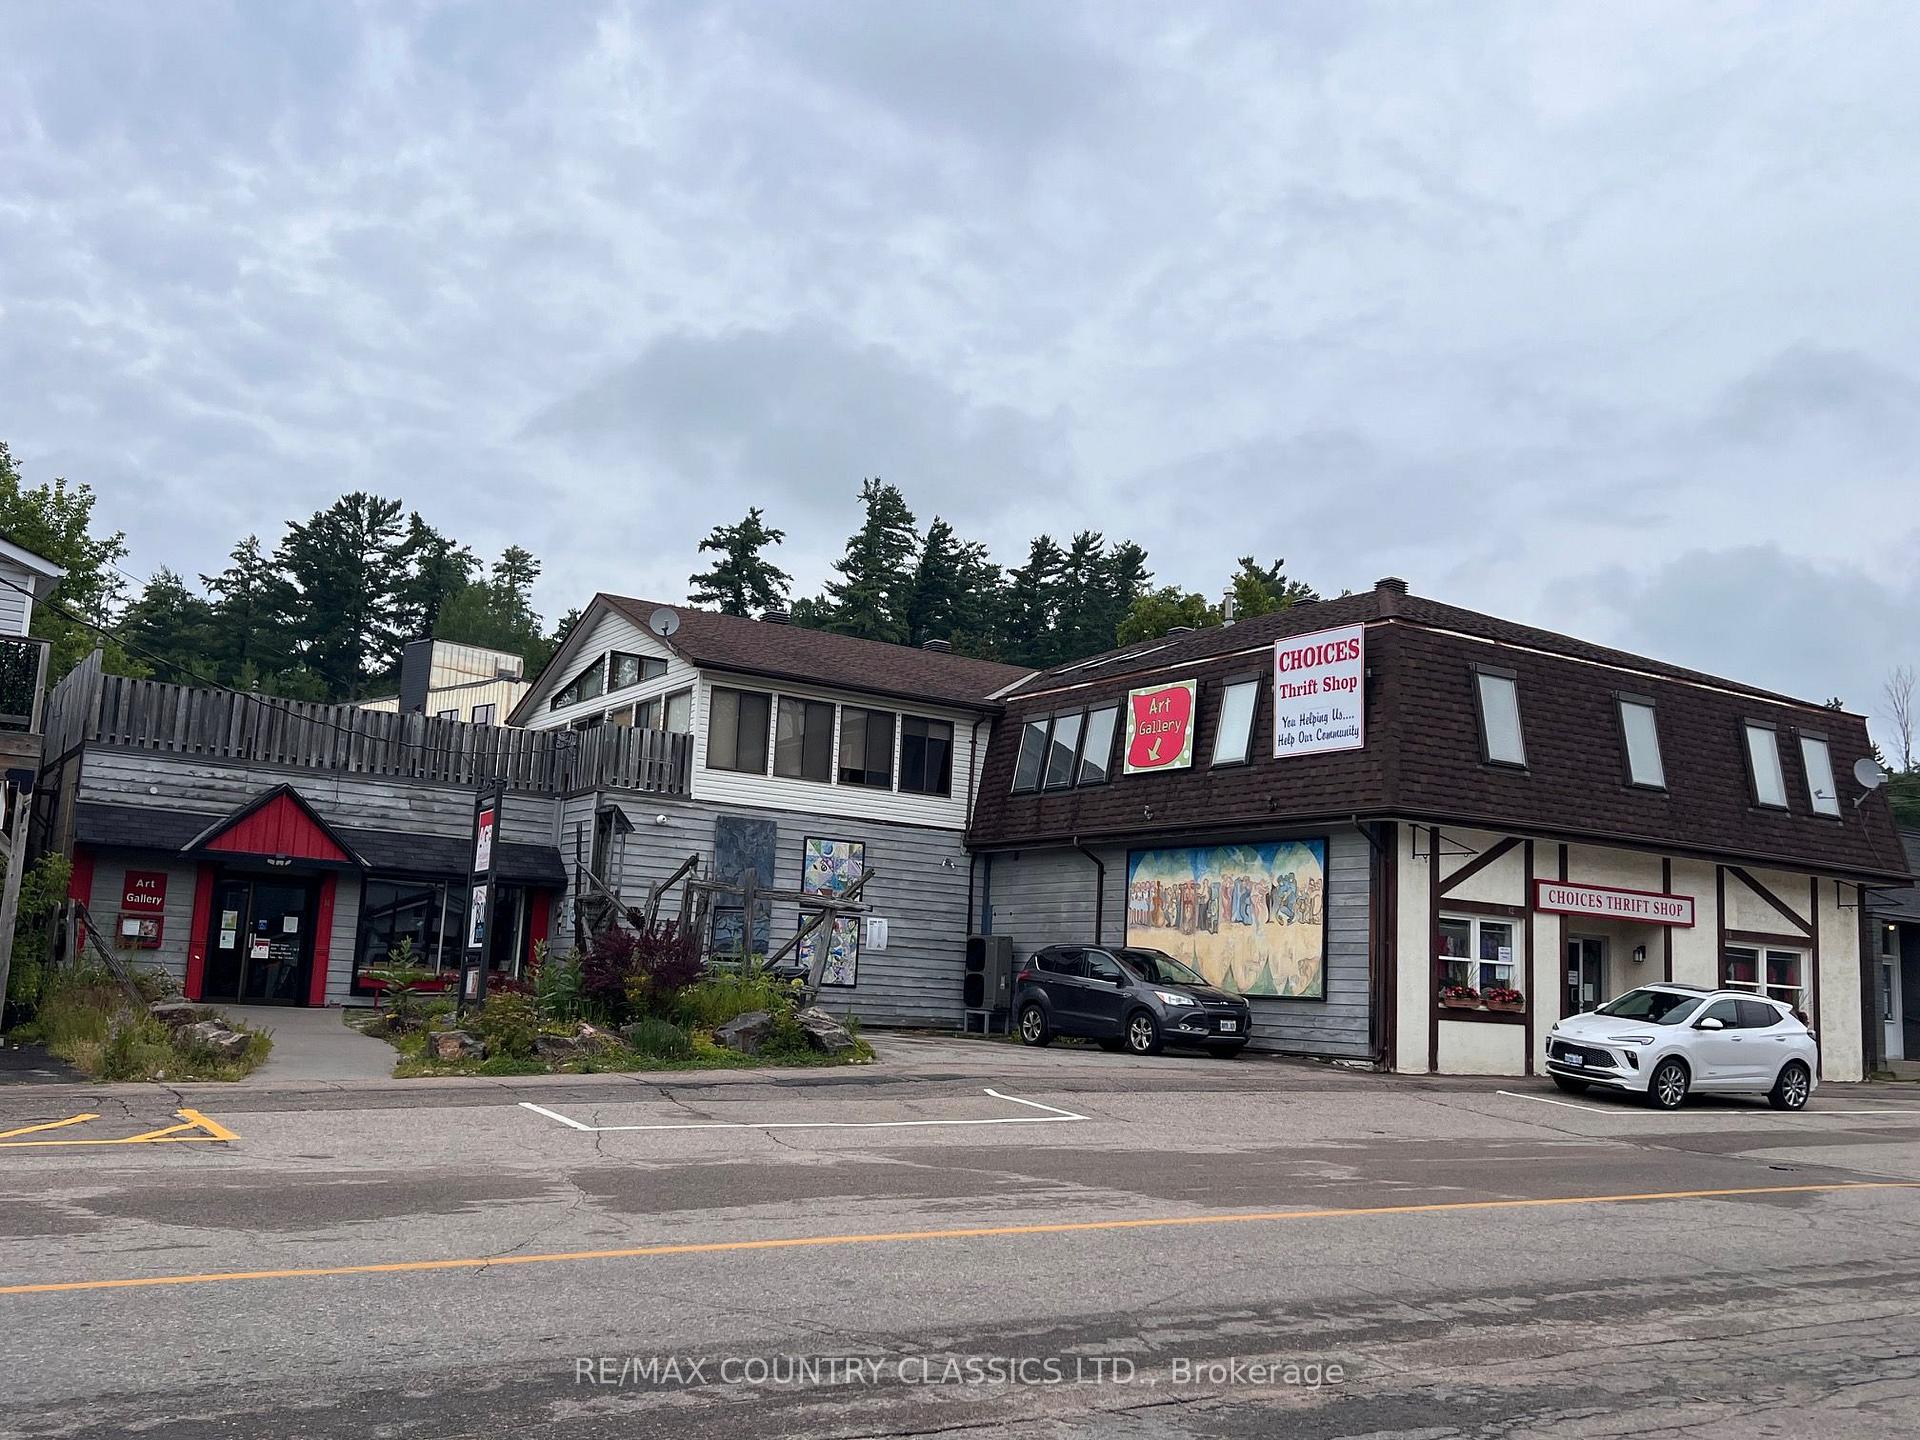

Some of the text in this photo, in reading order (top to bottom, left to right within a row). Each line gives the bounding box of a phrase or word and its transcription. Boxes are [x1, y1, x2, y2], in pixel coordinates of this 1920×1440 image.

[1279, 638, 1360, 673] CHOICES
[1280, 675, 1358, 700] Thrift Shop
[1149, 697, 1171, 715] Art
[1139, 719, 1182, 735] Gallery
[1282, 716, 1297, 728] You
[1299, 711, 1329, 726] Helping
[1278, 724, 1360, 747] Help Our Community
[136, 879, 156, 888] Art
[126, 892, 163, 906] Gallery
[1549, 889, 1684, 917] CHOICES THRIFT SHOP
